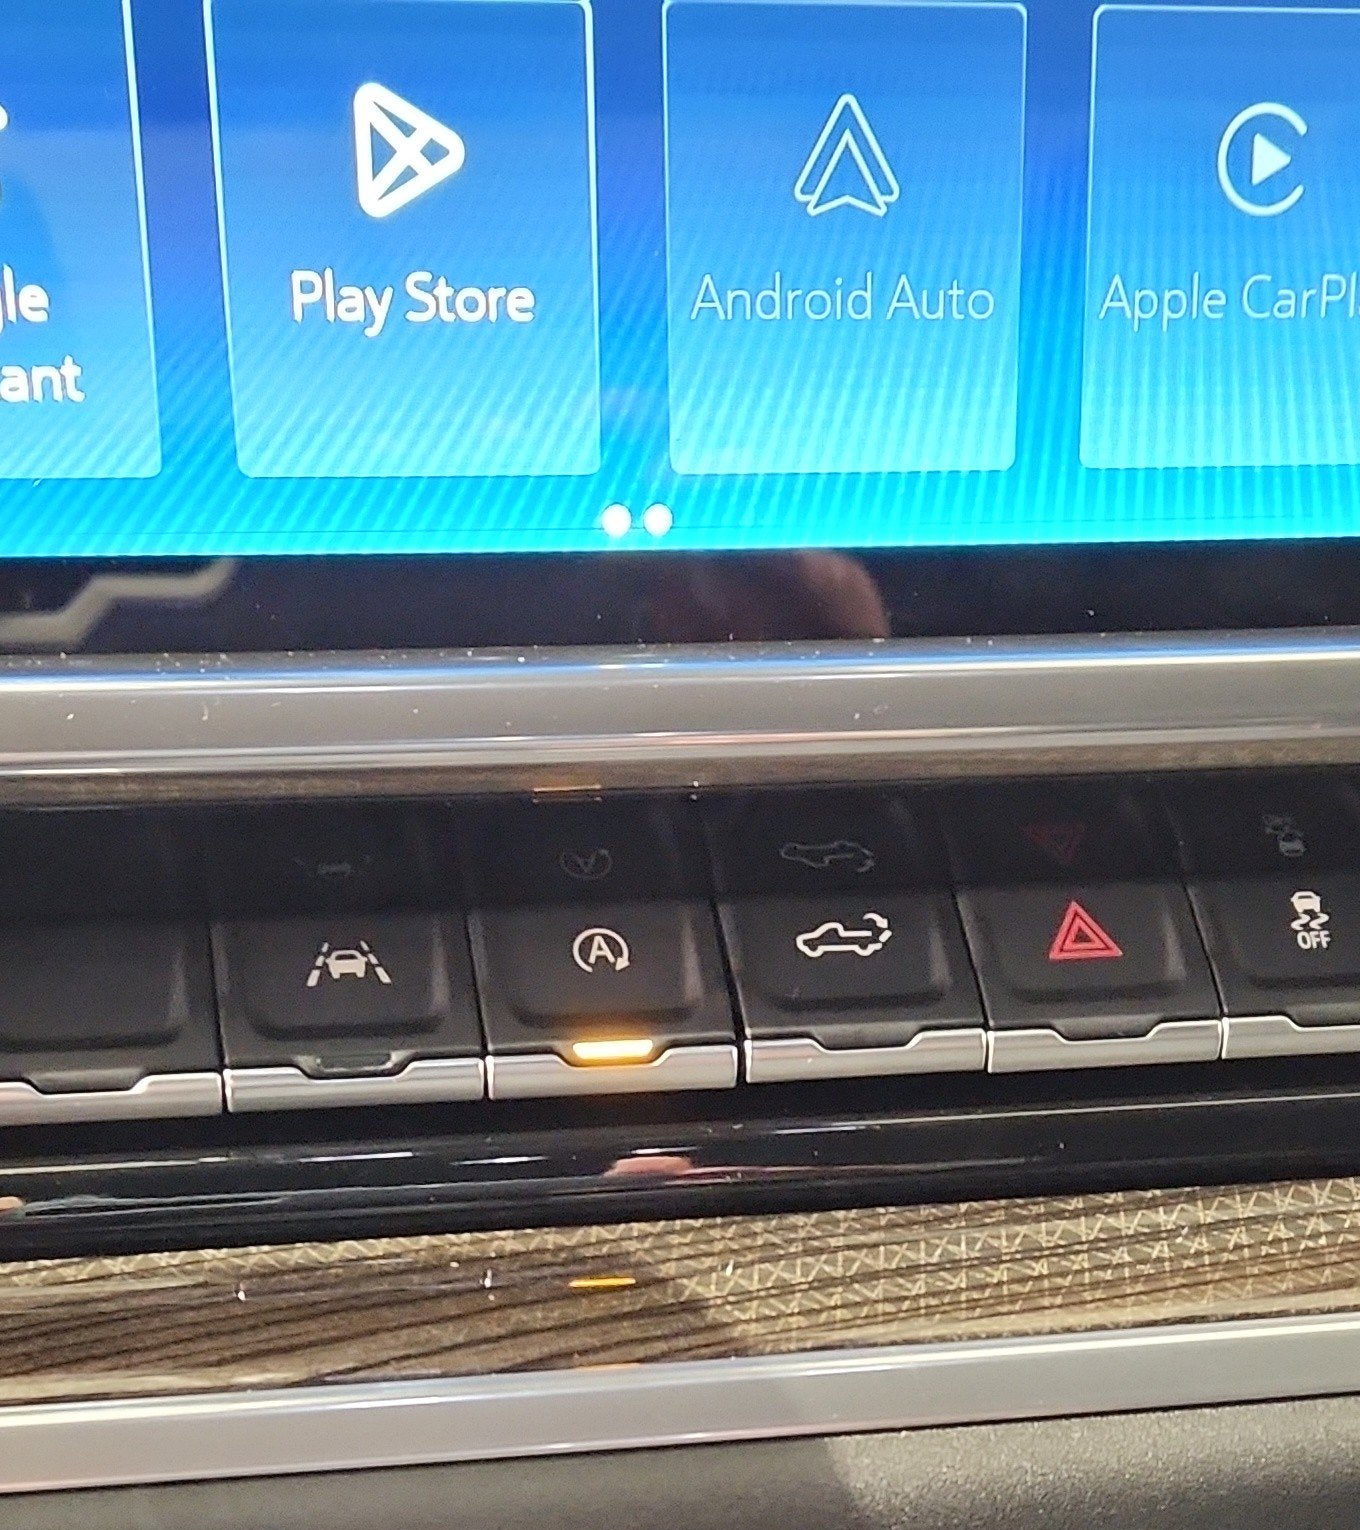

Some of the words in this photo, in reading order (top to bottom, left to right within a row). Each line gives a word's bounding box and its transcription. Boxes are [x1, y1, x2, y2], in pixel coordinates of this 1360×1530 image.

[290, 267, 395, 338] Play
[404, 271, 536, 323] Store
[690, 271, 873, 321] Android
[885, 274, 995, 320] Auto
[1098, 273, 1228, 332] Apple
[1297, 930, 1330, 950] OFF
